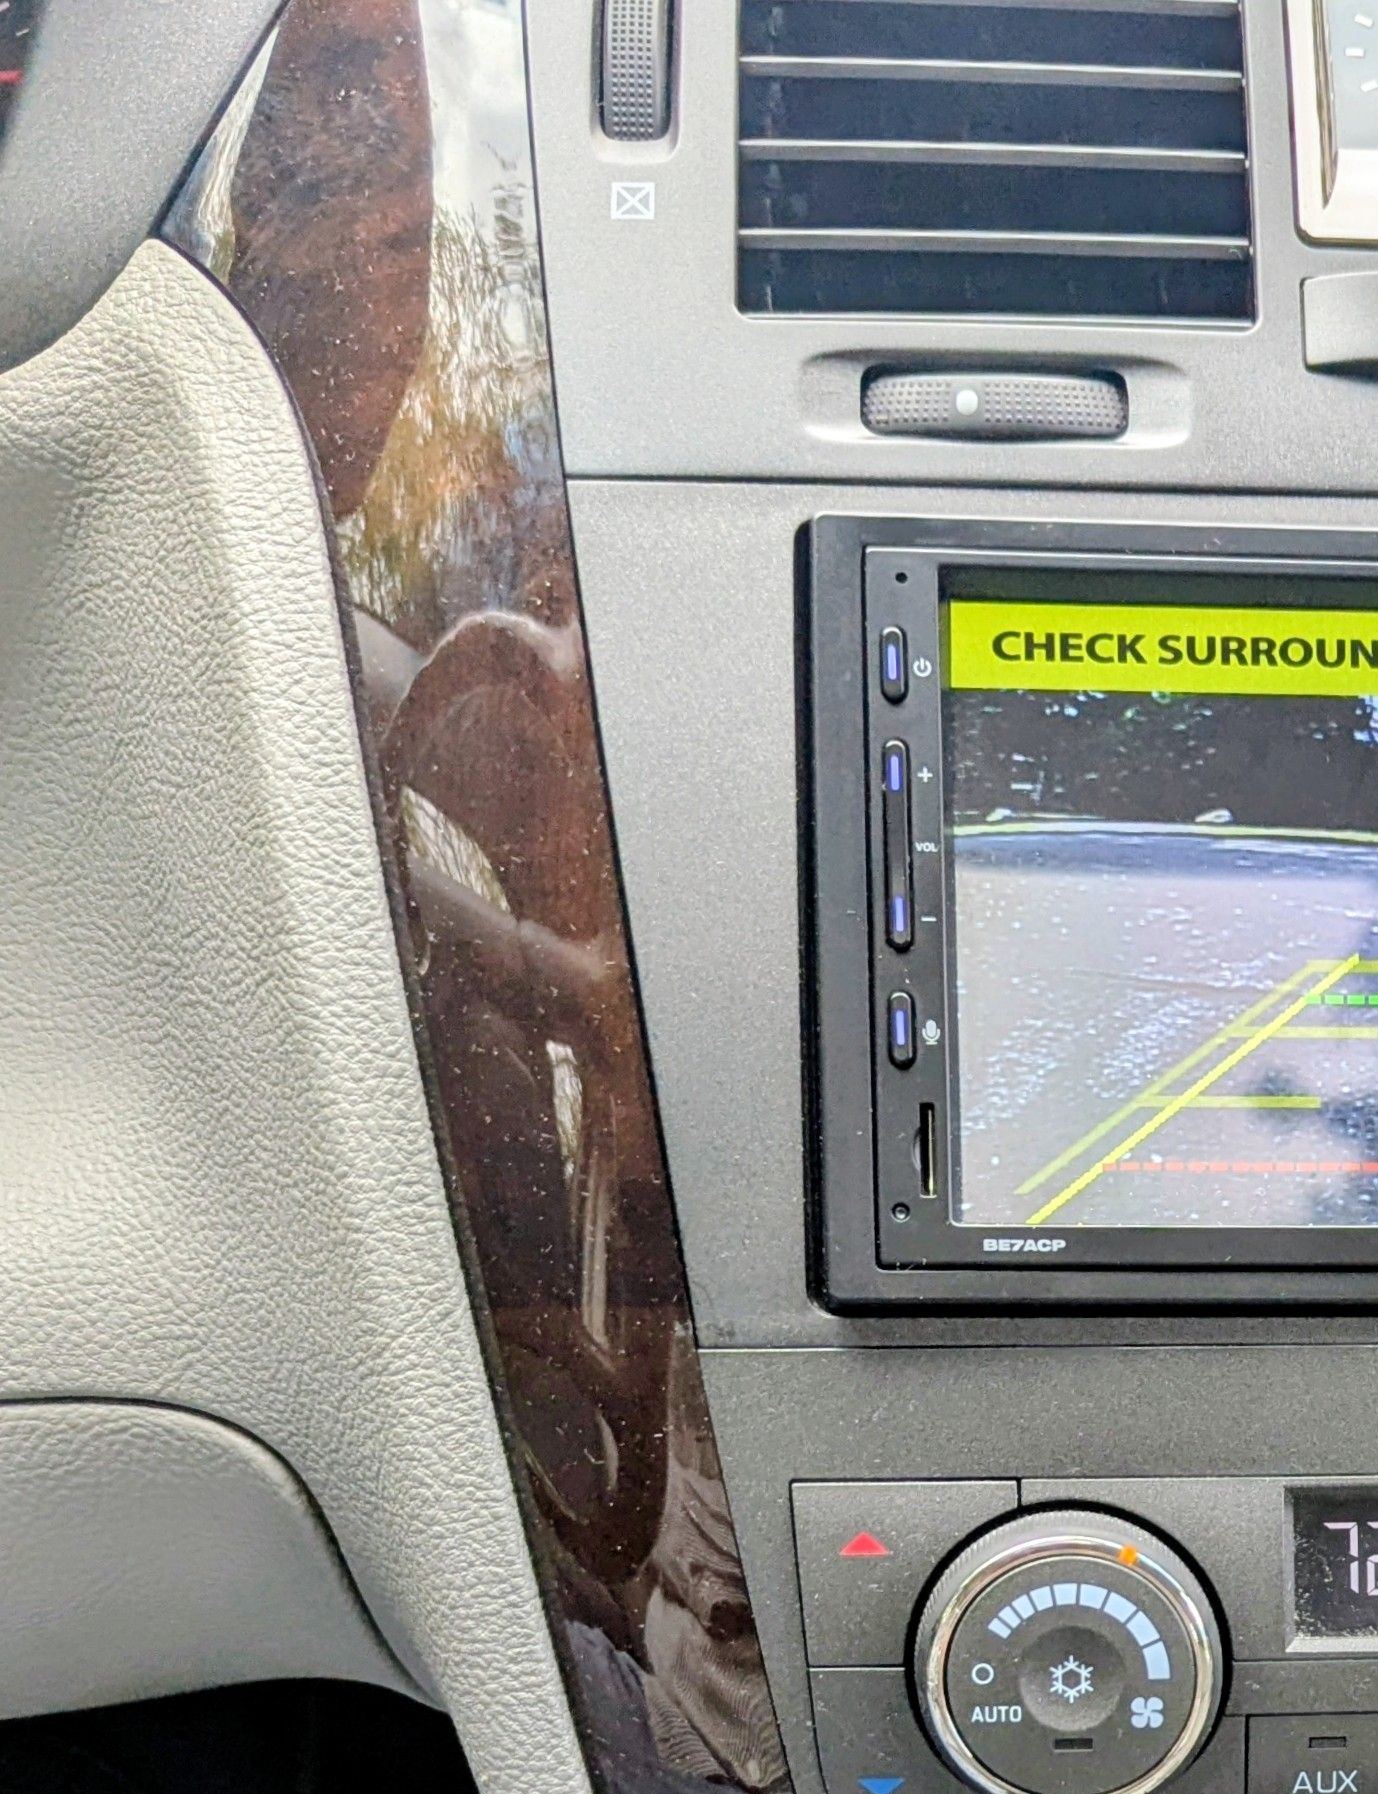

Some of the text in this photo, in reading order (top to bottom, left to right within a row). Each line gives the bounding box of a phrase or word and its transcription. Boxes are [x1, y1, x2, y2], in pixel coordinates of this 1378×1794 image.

[991, 630, 1147, 665] CHECK
[915, 841, 938, 853] VOL
[982, 1238, 1067, 1252] BE7ACP
[971, 1705, 1022, 1723] AUTO
[1292, 1770, 1358, 1794] AUX
